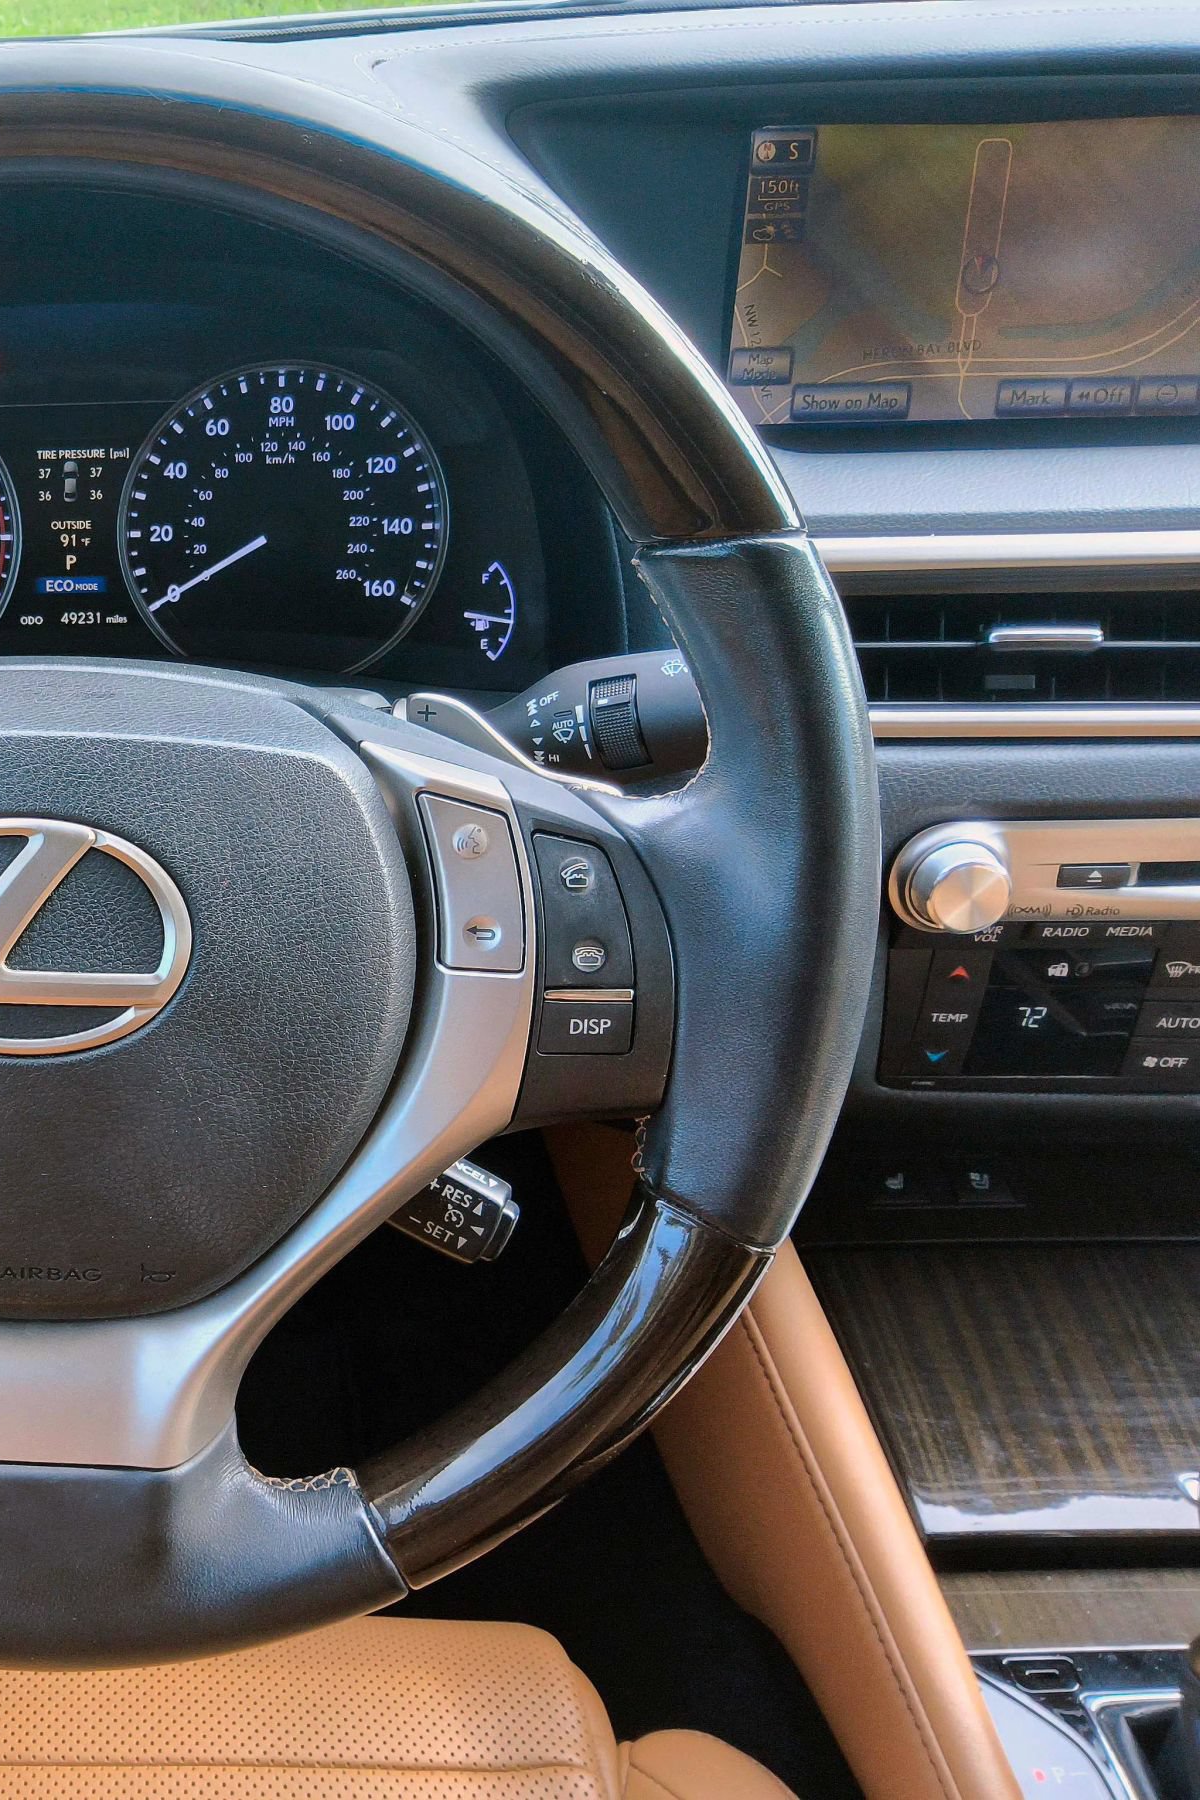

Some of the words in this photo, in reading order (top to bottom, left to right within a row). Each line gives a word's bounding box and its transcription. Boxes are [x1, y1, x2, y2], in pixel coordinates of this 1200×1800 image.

[789, 142, 799, 160] S
[760, 180, 799, 195] 150ft
[764, 202, 791, 212] GPS
[748, 355, 774, 368] Map
[802, 394, 840, 411] Show
[845, 397, 862, 408] on
[867, 392, 898, 410] Map
[1010, 389, 1051, 406] Mark
[1093, 388, 1123, 405] Off
[269, 397, 294, 413] 80
[205, 419, 230, 436] 60
[268, 416, 294, 428] MPH
[324, 414, 355, 431] 100
[260, 442, 278, 452] 120
[287, 441, 306, 452] 140
[37, 450, 57, 460] TIRE
[59, 449, 106, 459] PRESSURE
[234, 452, 253, 463] 100
[265, 453, 295, 465] km/h
[312, 452, 331, 463] 160
[163, 462, 187, 479] 40
[366, 456, 397, 474] 120
[38, 468, 51, 479] 37
[89, 467, 103, 478] 37
[214, 468, 229, 479] 80
[332, 468, 351, 479] 180
[38, 490, 52, 501] 36
[89, 489, 103, 500] 36
[199, 490, 213, 501] 60
[343, 490, 364, 501] 200
[50, 520, 92, 530] OUTSIDE
[191, 517, 205, 528] 40
[349, 516, 370, 527] 220
[381, 517, 413, 535] 140
[150, 525, 173, 542] 20
[60, 533, 77, 547] 91
[193, 544, 207, 555] 20
[347, 543, 368, 554] 240
[66, 554, 77, 571] P
[335, 570, 356, 580] 260
[481, 573, 490, 585] F
[45, 579, 74, 592] ECO
[75, 582, 99, 591] MODE
[362, 580, 395, 597] 160
[20, 615, 43, 625] ODO
[60, 612, 101, 625] 49231
[106, 614, 128, 624] miles
[480, 638, 489, 650] E
[539, 691, 560, 706] OFF
[551, 719, 574, 731] AUTO
[548, 753, 560, 763] HI
[1086, 906, 1120, 916] Radio
[982, 925, 1004, 935] WR
[1042, 927, 1090, 938] RADIO
[1105, 926, 1153, 937] MEDIA
[974, 934, 999, 943] VOL
[931, 1012, 968, 1024] TEMP
[1018, 1006, 1048, 1028] 72
[1155, 1017, 1200, 1029] AUTO
[569, 1018, 612, 1035] DISP
[1159, 1056, 1189, 1068] OFF
[453, 1161, 488, 1186] NCEL
[441, 1184, 473, 1209] RES
[423, 1220, 455, 1244] SET
[0, 1266, 103, 1283] AIRBAG
